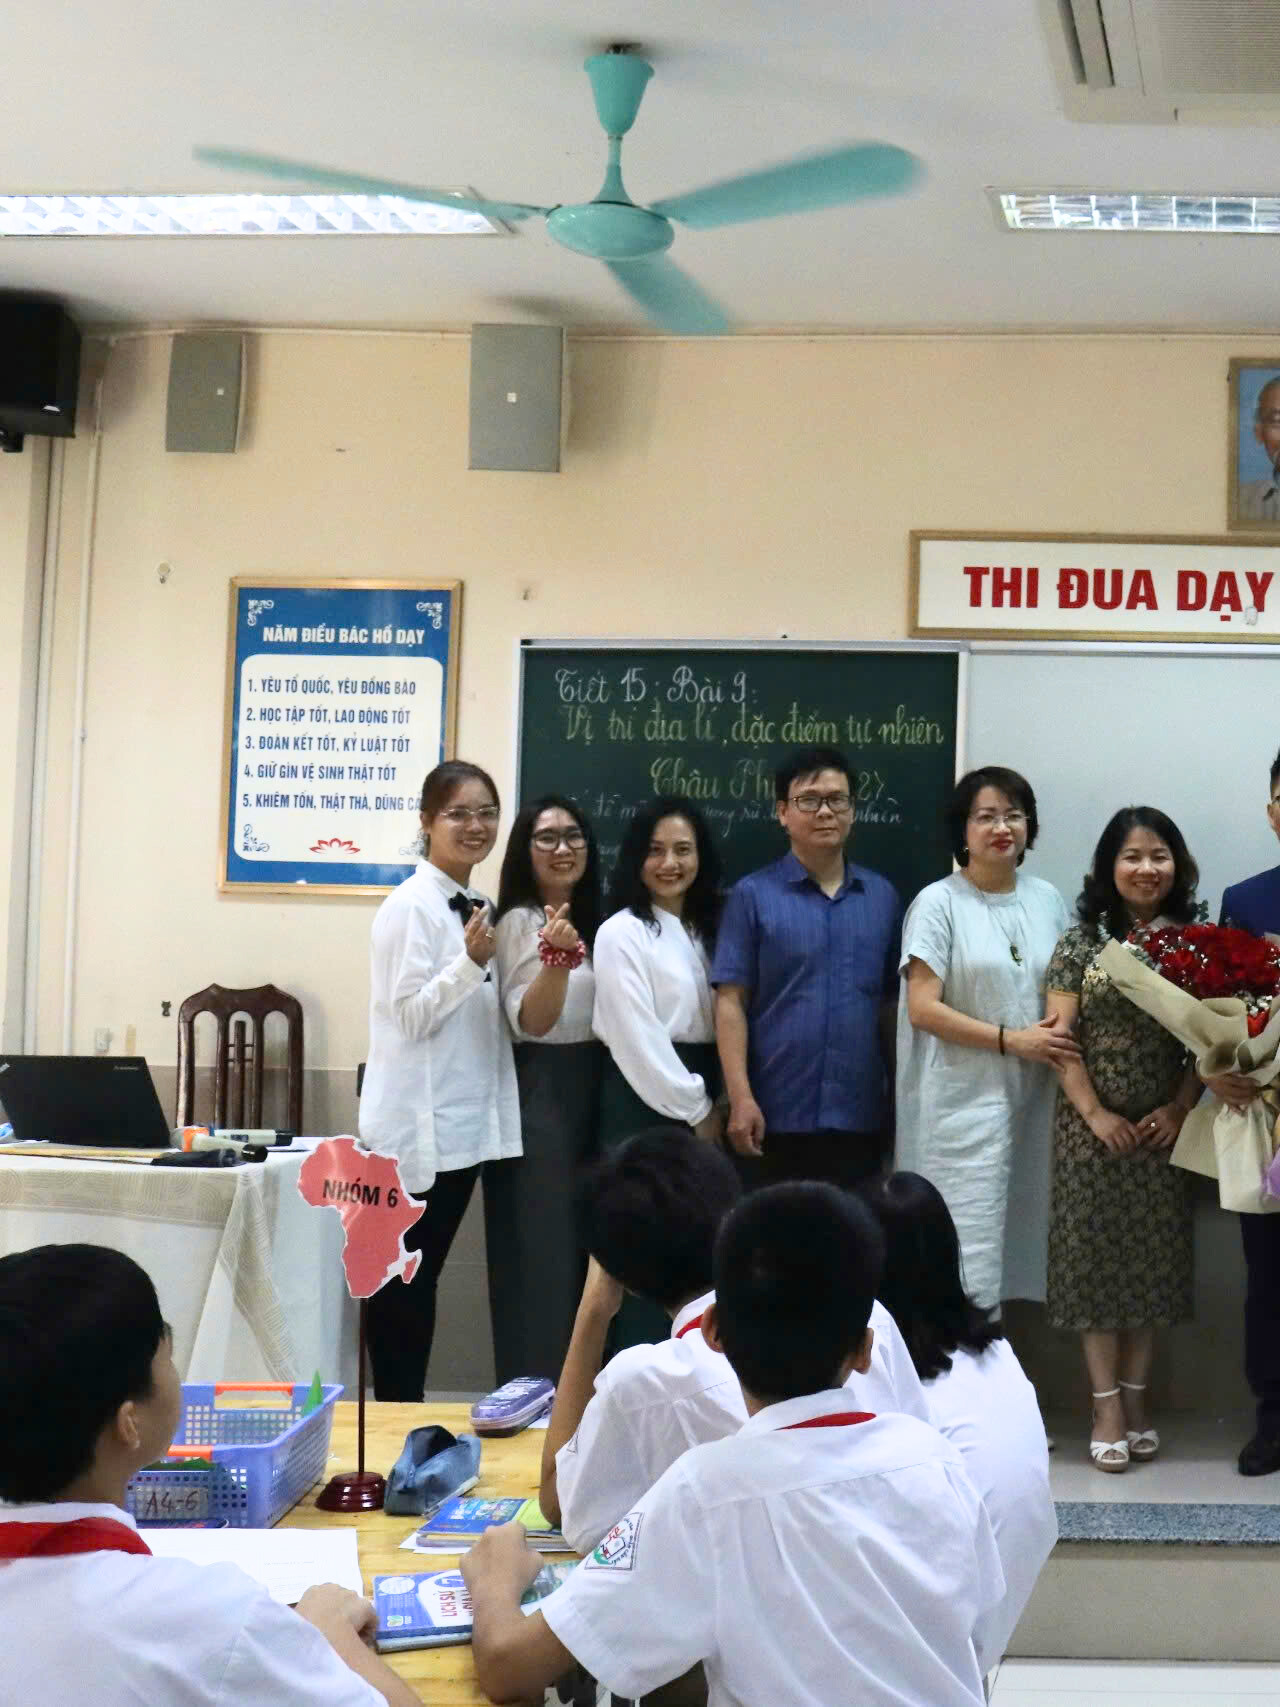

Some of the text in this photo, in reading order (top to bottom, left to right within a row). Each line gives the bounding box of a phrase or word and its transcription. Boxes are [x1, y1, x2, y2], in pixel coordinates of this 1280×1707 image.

[963, 565, 1040, 609] THI
[1056, 568, 1159, 611] ĐUA
[1176, 570, 1274, 622] DẠY
[263, 623, 425, 647] NĂM ĐIỀU BÁC HỒ DẠY
[248, 679, 257, 692] 1.
[261, 676, 281, 692] YÊU
[301, 674, 333, 695] QUỐC,
[338, 676, 357, 694] YÊU
[555, 668, 609, 703] Tiết
[667, 665, 725, 702] Bài
[246, 704, 410, 727] 2. HỌC TẬP TỐT, LAO ĐỘNG TỐT
[644, 701, 687, 747] địa
[731, 702, 776, 750] đặc
[782, 702, 839, 745] điểm
[878, 704, 945, 745] nhiên
[245, 736, 255, 749] 3.
[293, 732, 313, 751] KẾT
[317, 732, 339, 752] TỐT,
[361, 735, 387, 755] LUẬT
[392, 733, 410, 752] TỐT
[244, 765, 254, 779] 4.
[257, 761, 277, 778] GIỮ
[302, 762, 314, 782] VỆ
[318, 766, 344, 780] SINH
[348, 763, 374, 783] THẬT
[378, 762, 396, 780] TỐT
[650, 757, 721, 800] Châu
[243, 794, 252, 808] 5.
[255, 791, 290, 809] KHIÊM
[320, 792, 346, 812] THẬT
[375, 795, 404, 811] DŨNG
[323, 1177, 398, 1208] NHÓM 6
